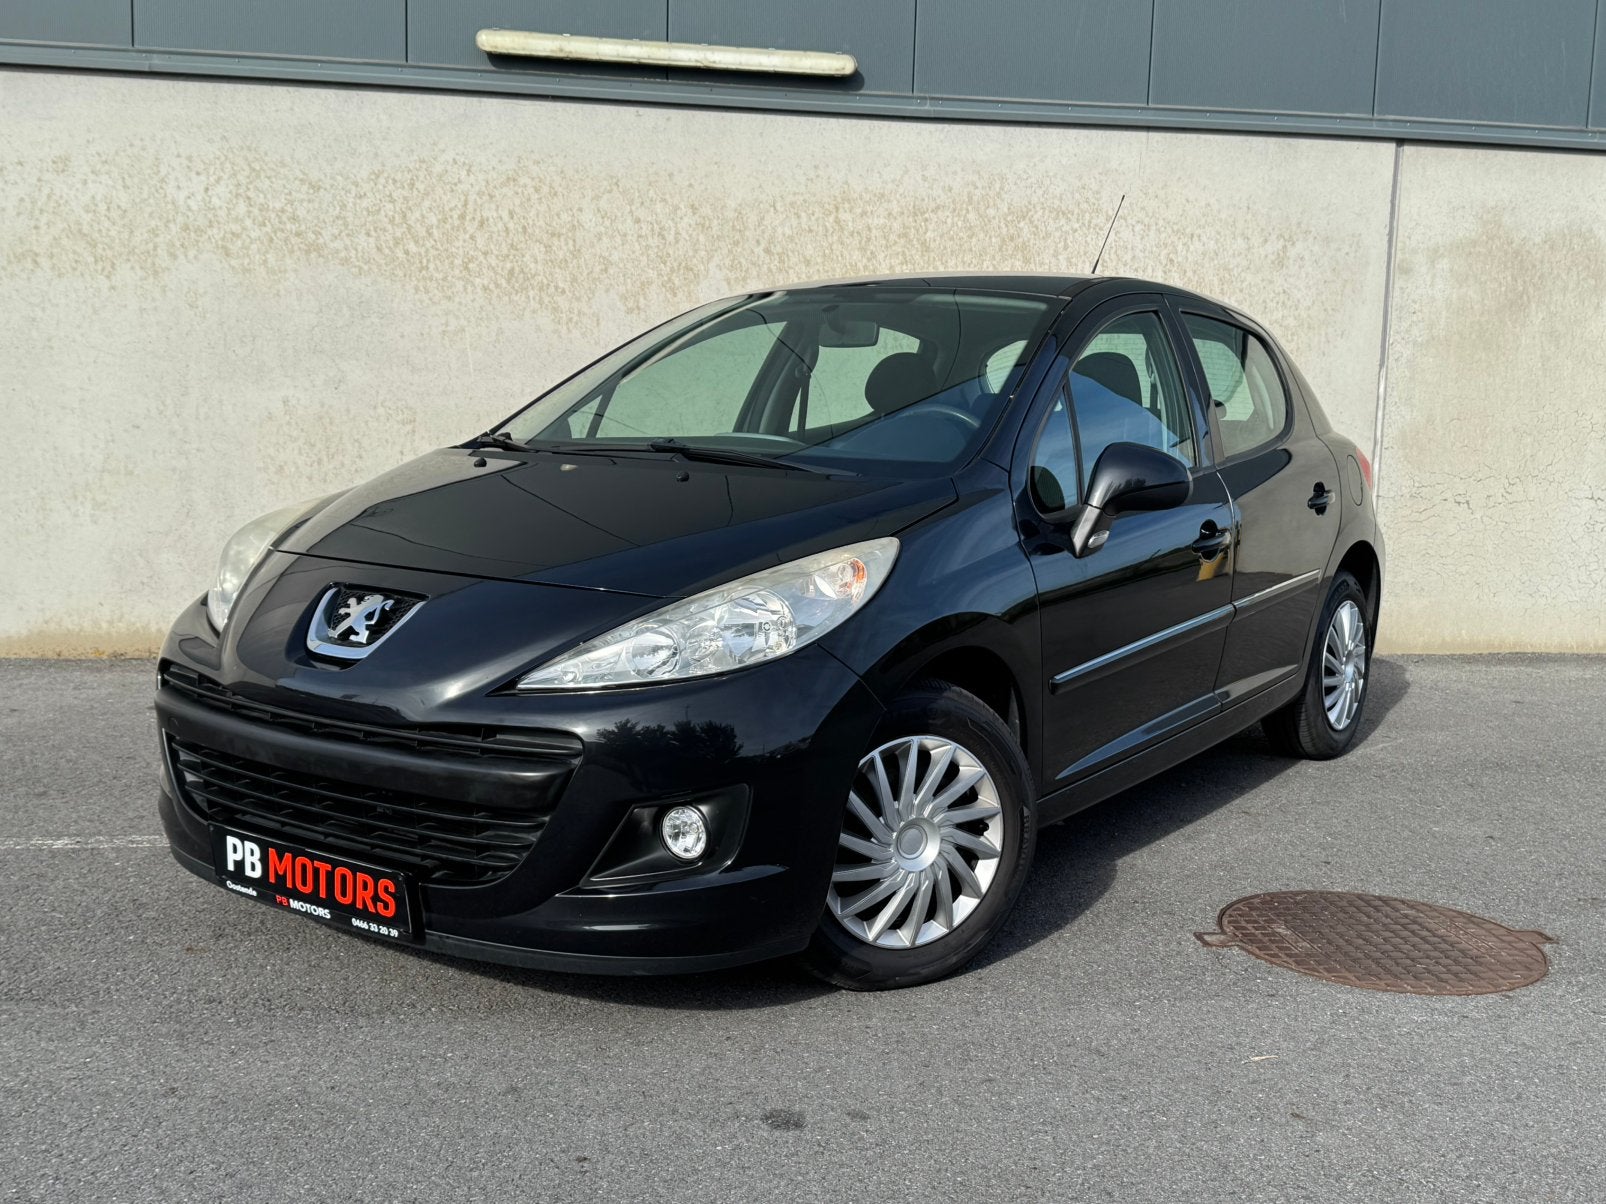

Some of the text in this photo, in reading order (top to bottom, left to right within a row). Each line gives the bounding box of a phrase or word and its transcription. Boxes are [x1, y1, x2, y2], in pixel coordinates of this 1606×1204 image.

[226, 835, 396, 918] PB MOTORS
[276, 894, 331, 919] PB MOTORS
[352, 918, 369, 930] 0466
[369, 923, 378, 932] 33
[379, 925, 388, 935] 20
